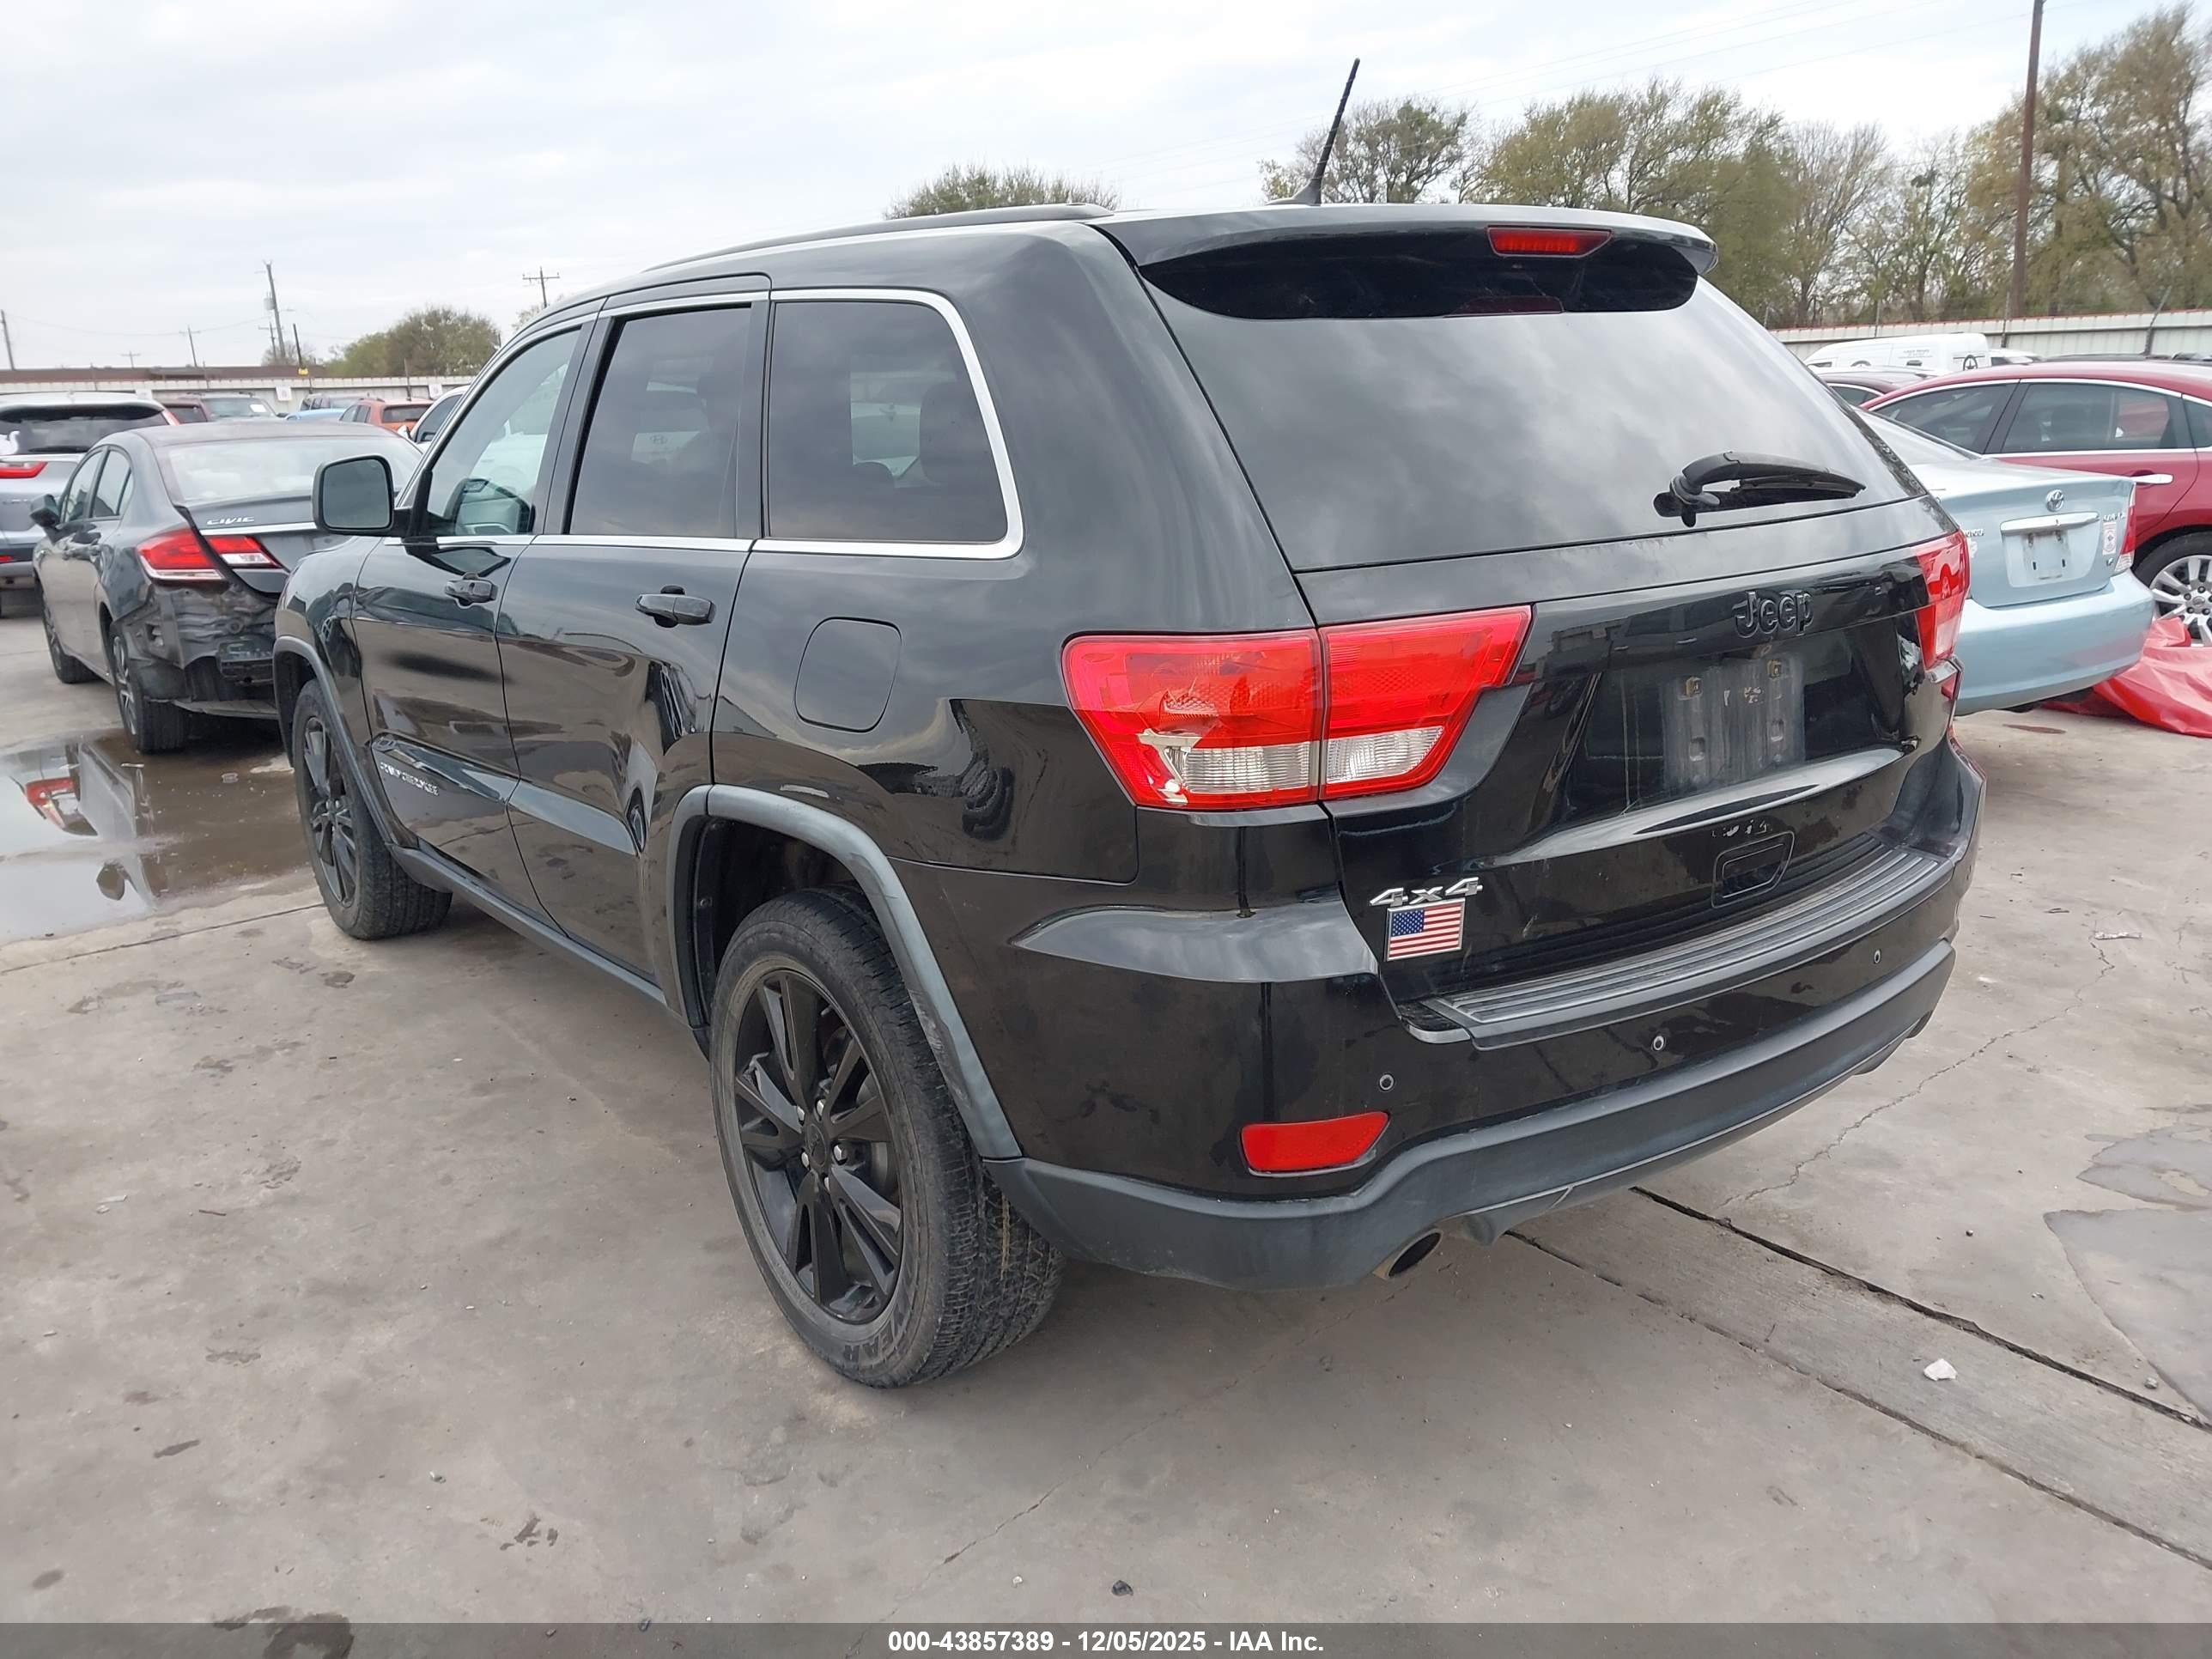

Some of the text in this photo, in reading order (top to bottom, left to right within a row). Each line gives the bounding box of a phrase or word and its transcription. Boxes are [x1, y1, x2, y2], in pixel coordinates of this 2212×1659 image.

[206, 516, 255, 526] CIVIC
[1732, 589, 1814, 638] Jeep
[1368, 876, 1484, 908] 4x4
